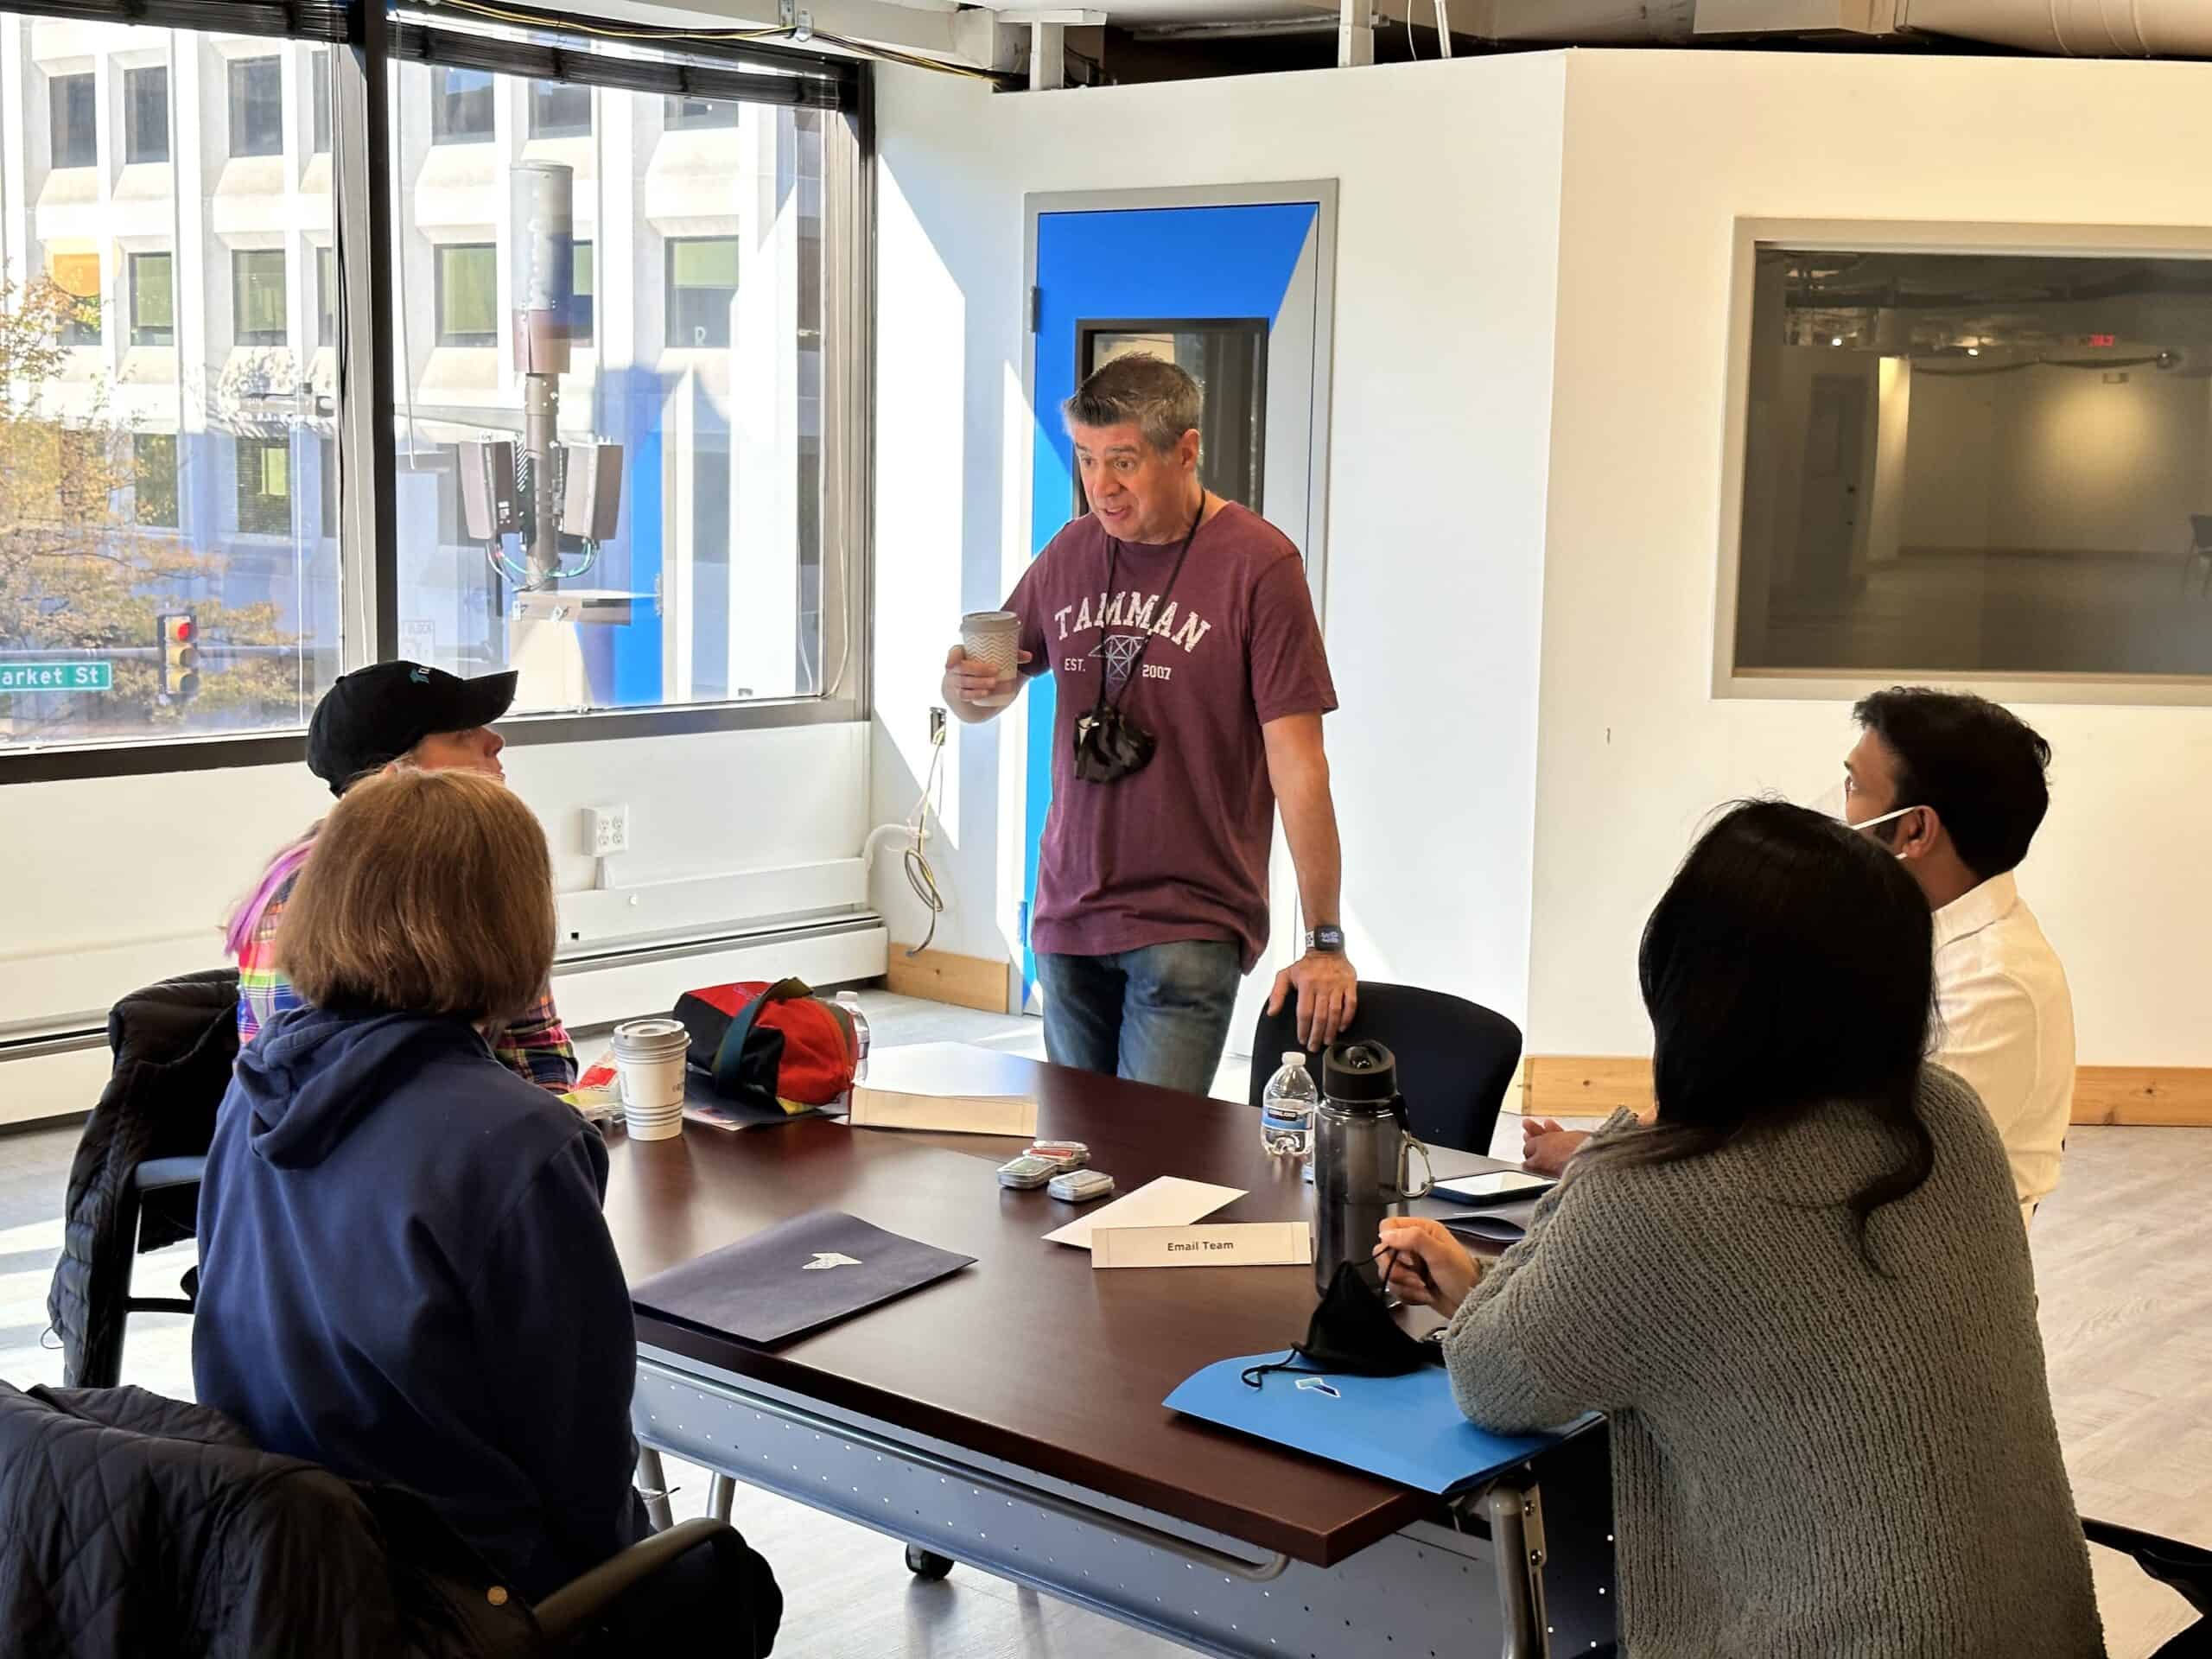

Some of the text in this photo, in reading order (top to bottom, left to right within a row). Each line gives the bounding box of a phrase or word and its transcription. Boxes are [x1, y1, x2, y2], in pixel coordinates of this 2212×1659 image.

[1054, 591, 1211, 653] TAMMAN
[75, 666, 99, 683] St
[1065, 658, 1172, 680] EST. 2007
[1167, 1241, 1234, 1251] Email Team
